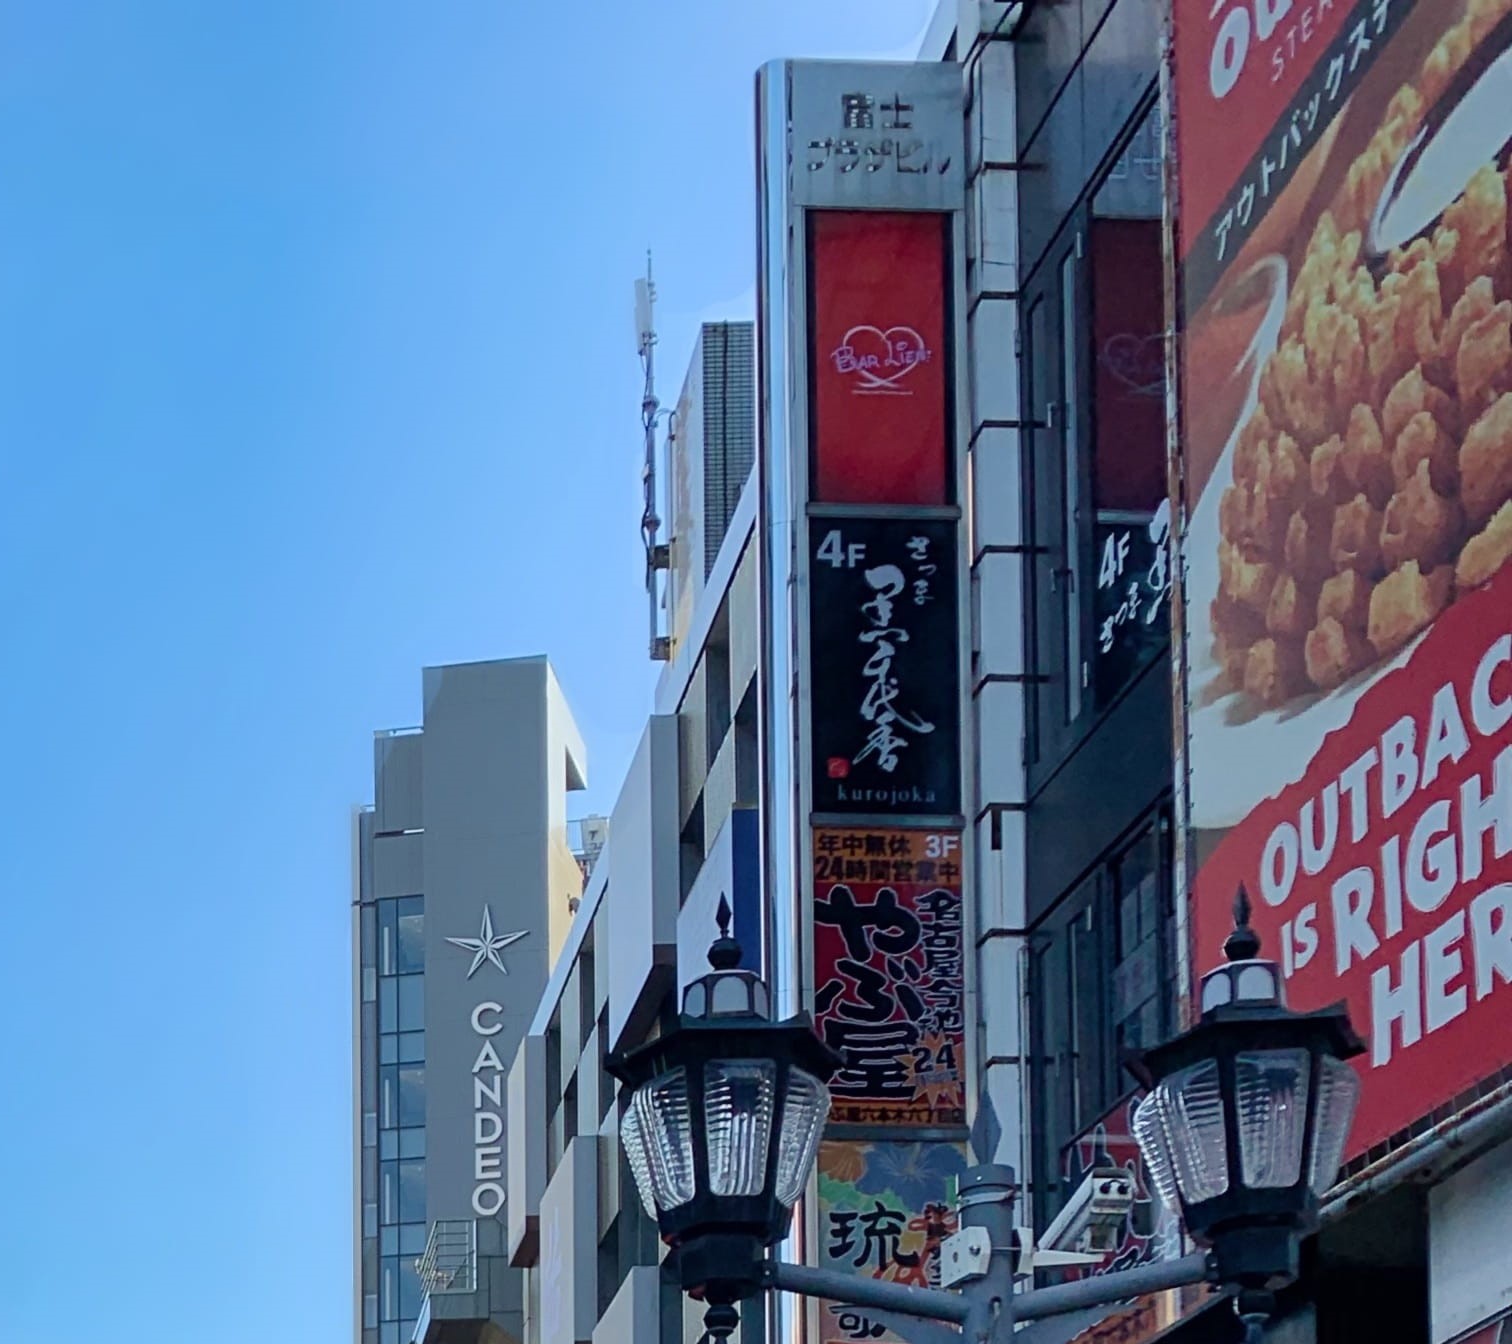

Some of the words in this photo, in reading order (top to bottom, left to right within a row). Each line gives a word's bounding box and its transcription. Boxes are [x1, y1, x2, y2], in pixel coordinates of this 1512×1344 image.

[816, 529, 866, 569] 4F
[836, 782, 937, 806] kurojoka
[818, 834, 912, 858] 年中無休
[925, 835, 959, 859] 3F
[815, 857, 959, 884] 24時間営業中
[1280, 901, 1321, 980] IS
[814, 884, 922, 1100] やぶ屋
[912, 1044, 957, 1075] 24
[470, 1001, 505, 1218] CANDEO
